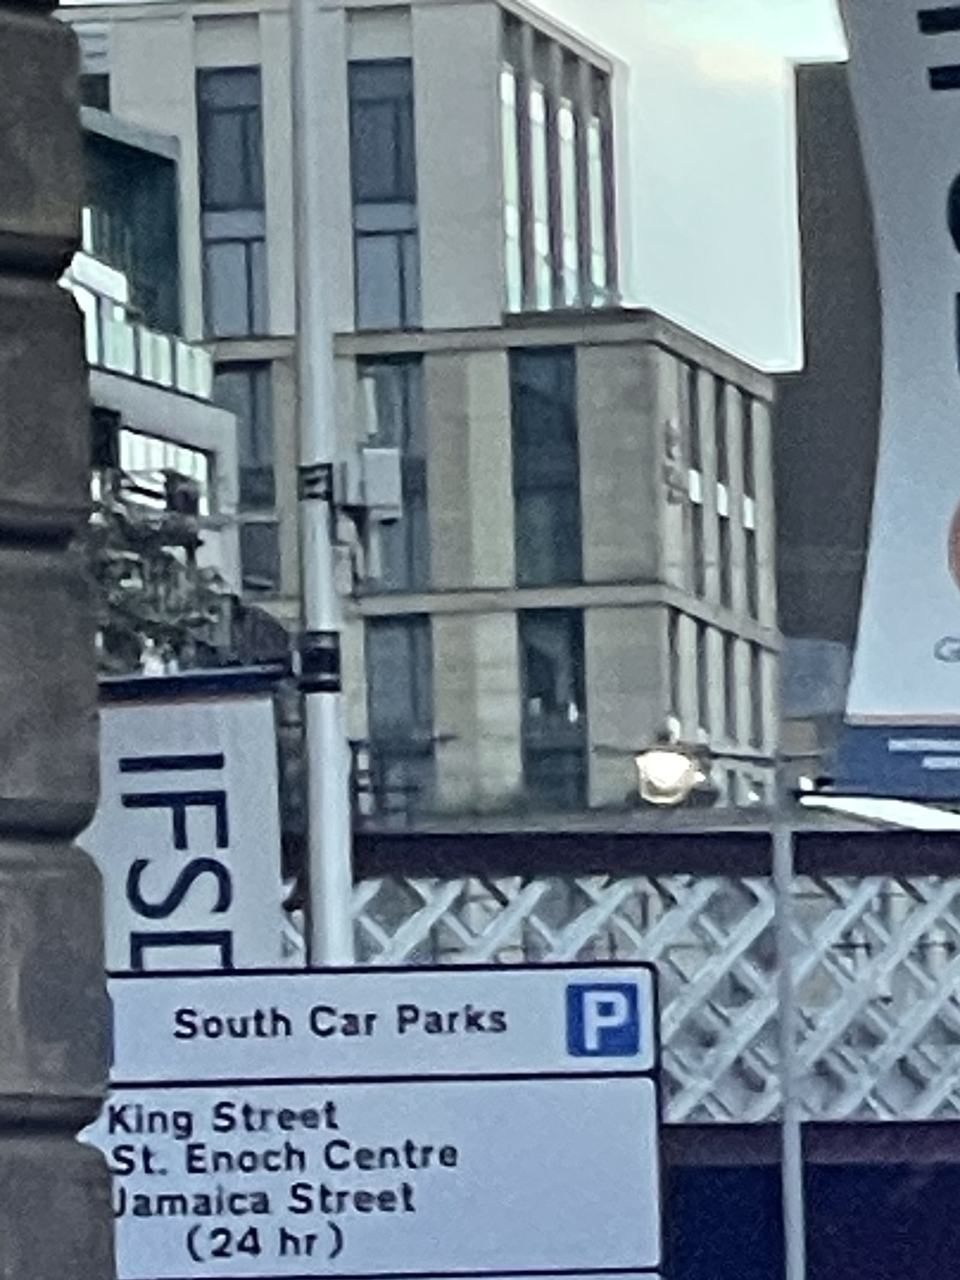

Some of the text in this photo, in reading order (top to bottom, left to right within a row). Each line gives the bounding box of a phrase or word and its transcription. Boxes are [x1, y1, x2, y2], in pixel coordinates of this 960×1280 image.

[173, 1003, 508, 1040] South Car Parks
[582, 990, 627, 1051] P
[107, 1100, 339, 1140] King Street
[110, 1138, 458, 1176] St. Enoch Centre
[114, 1181, 416, 1219] Jamaica Street
[186, 1222, 262, 1263] (24
